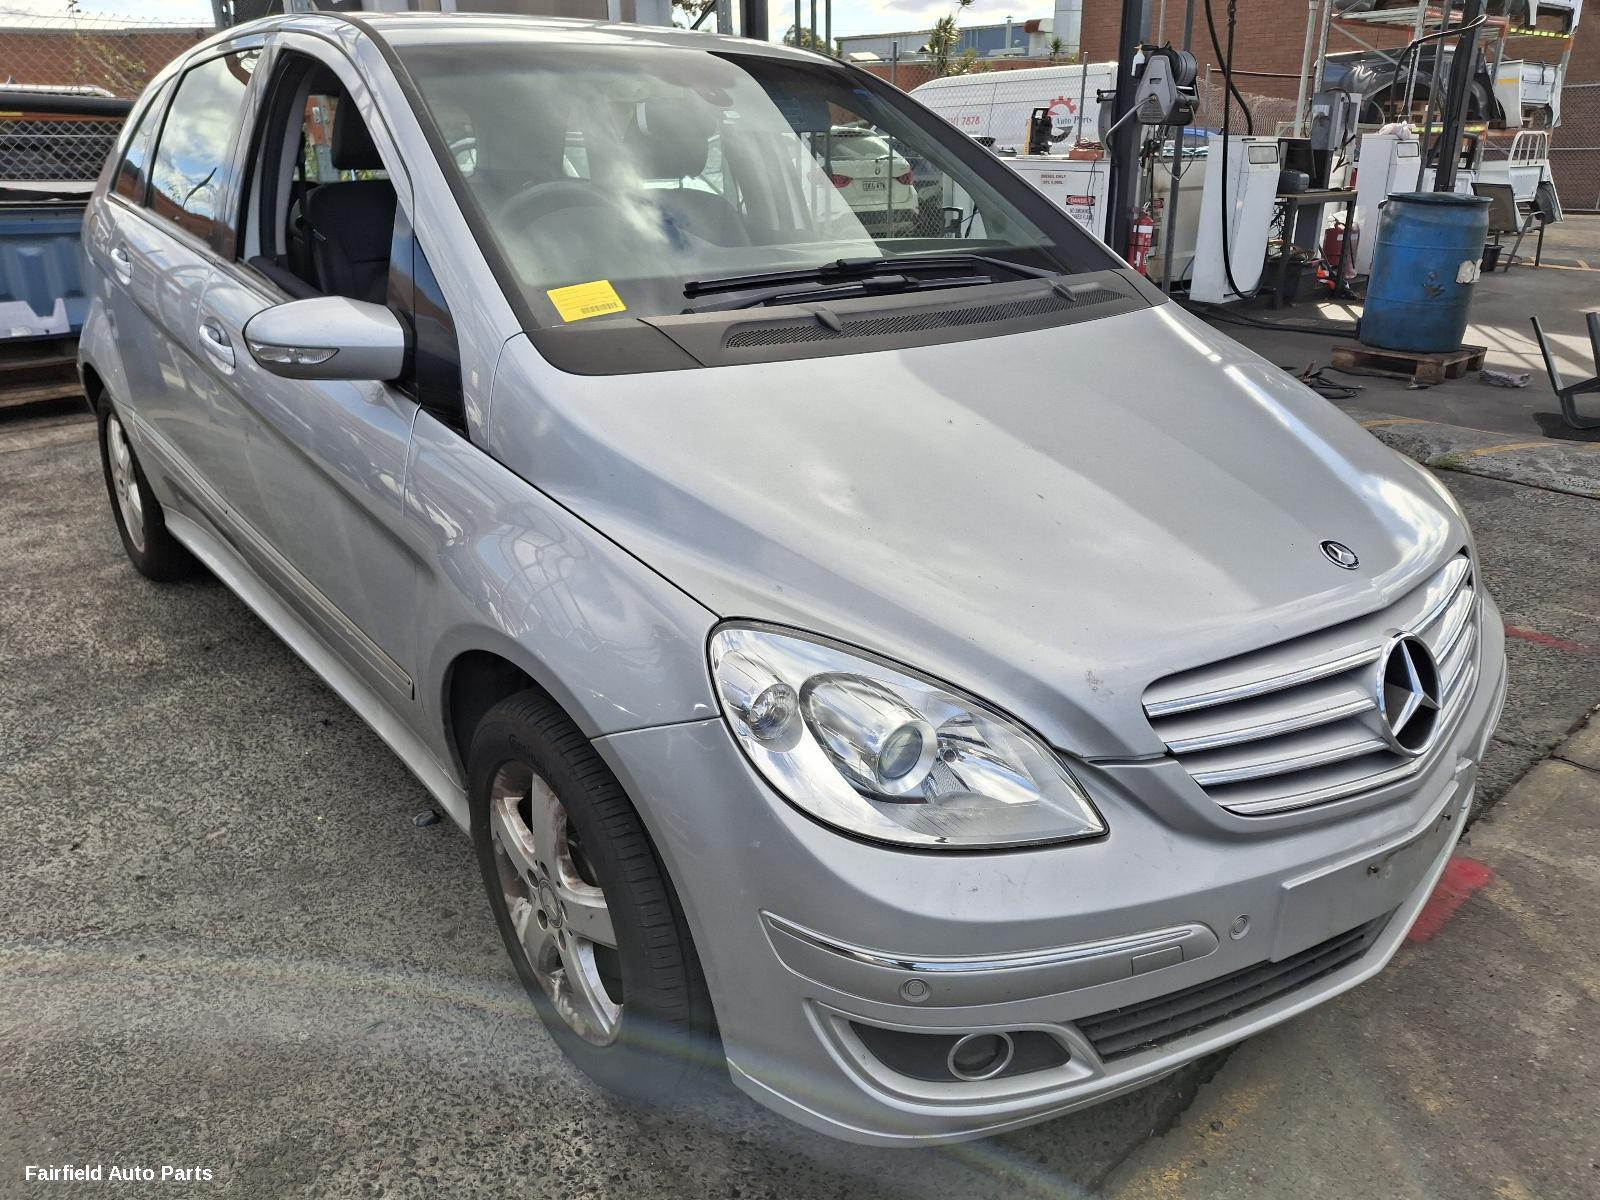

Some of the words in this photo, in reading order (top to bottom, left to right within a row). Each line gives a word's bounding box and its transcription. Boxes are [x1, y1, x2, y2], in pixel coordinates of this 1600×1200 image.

[962, 116, 980, 126] 7878
[1056, 117, 1071, 125] Auto
[1074, 115, 1093, 124] Prts
